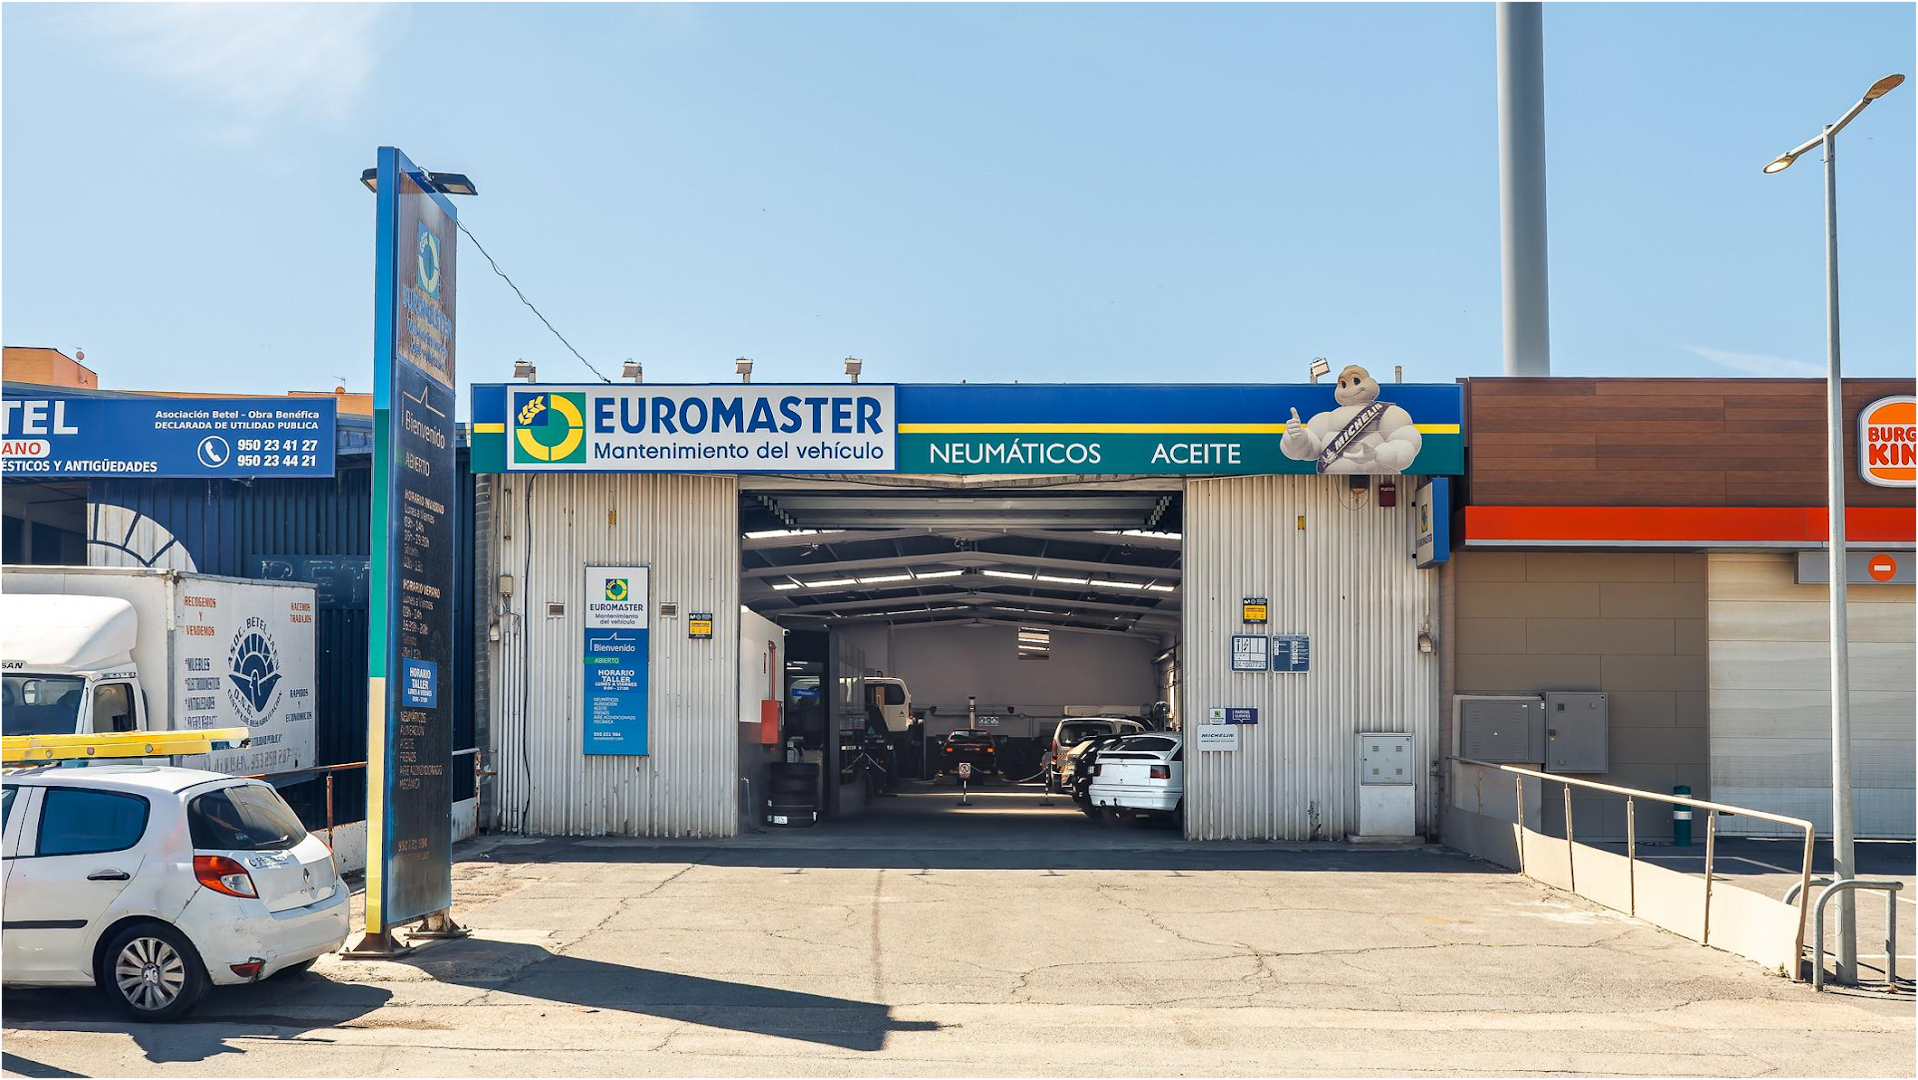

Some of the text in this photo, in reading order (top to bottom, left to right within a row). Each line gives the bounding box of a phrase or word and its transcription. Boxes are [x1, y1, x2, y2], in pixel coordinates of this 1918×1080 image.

[155, 410, 209, 419] Asociación
[212, 410, 239, 419] Betel
[248, 410, 273, 419] Obra
[275, 410, 320, 419] Benéfica
[594, 395, 884, 435] EUROMASTER
[154, 421, 319, 430] DECLARADA DE UTILIDAD PUBLICA
[405, 410, 446, 451] Bienvenido
[1334, 403, 1383, 451] MICHELIN
[1868, 426, 1917, 442] BURG
[2, 442, 42, 455] ANO
[237, 439, 318, 451] 950 23 41 27
[594, 442, 884, 459] Mantenimiento del vehículo
[929, 438, 1241, 465] NEUMÁTICOS ACEITE
[1, 459, 158, 473] ÉSTICOS Y ANTIGÜEDADES
[237, 455, 316, 467] 950 23 44 21
[405, 450, 431, 477] ABIERTO
[184, 596, 216, 608] RECOGEMOS
[290, 602, 311, 611] HACEMOS
[590, 603, 644, 611] EUROMASTER
[198, 611, 204, 622] Y
[290, 614, 312, 623] TRABAJOS
[186, 625, 215, 636] VENDEMOS
[246, 616, 267, 635] BETEL
[593, 643, 636, 652] Bienvenido
[409, 667, 431, 680] HORARIO
[411, 678, 429, 690] TALLER
[290, 688, 309, 698] RAPIDOS
[297, 700, 301, 709] Y
[285, 711, 312, 723] ECONOMICOS
